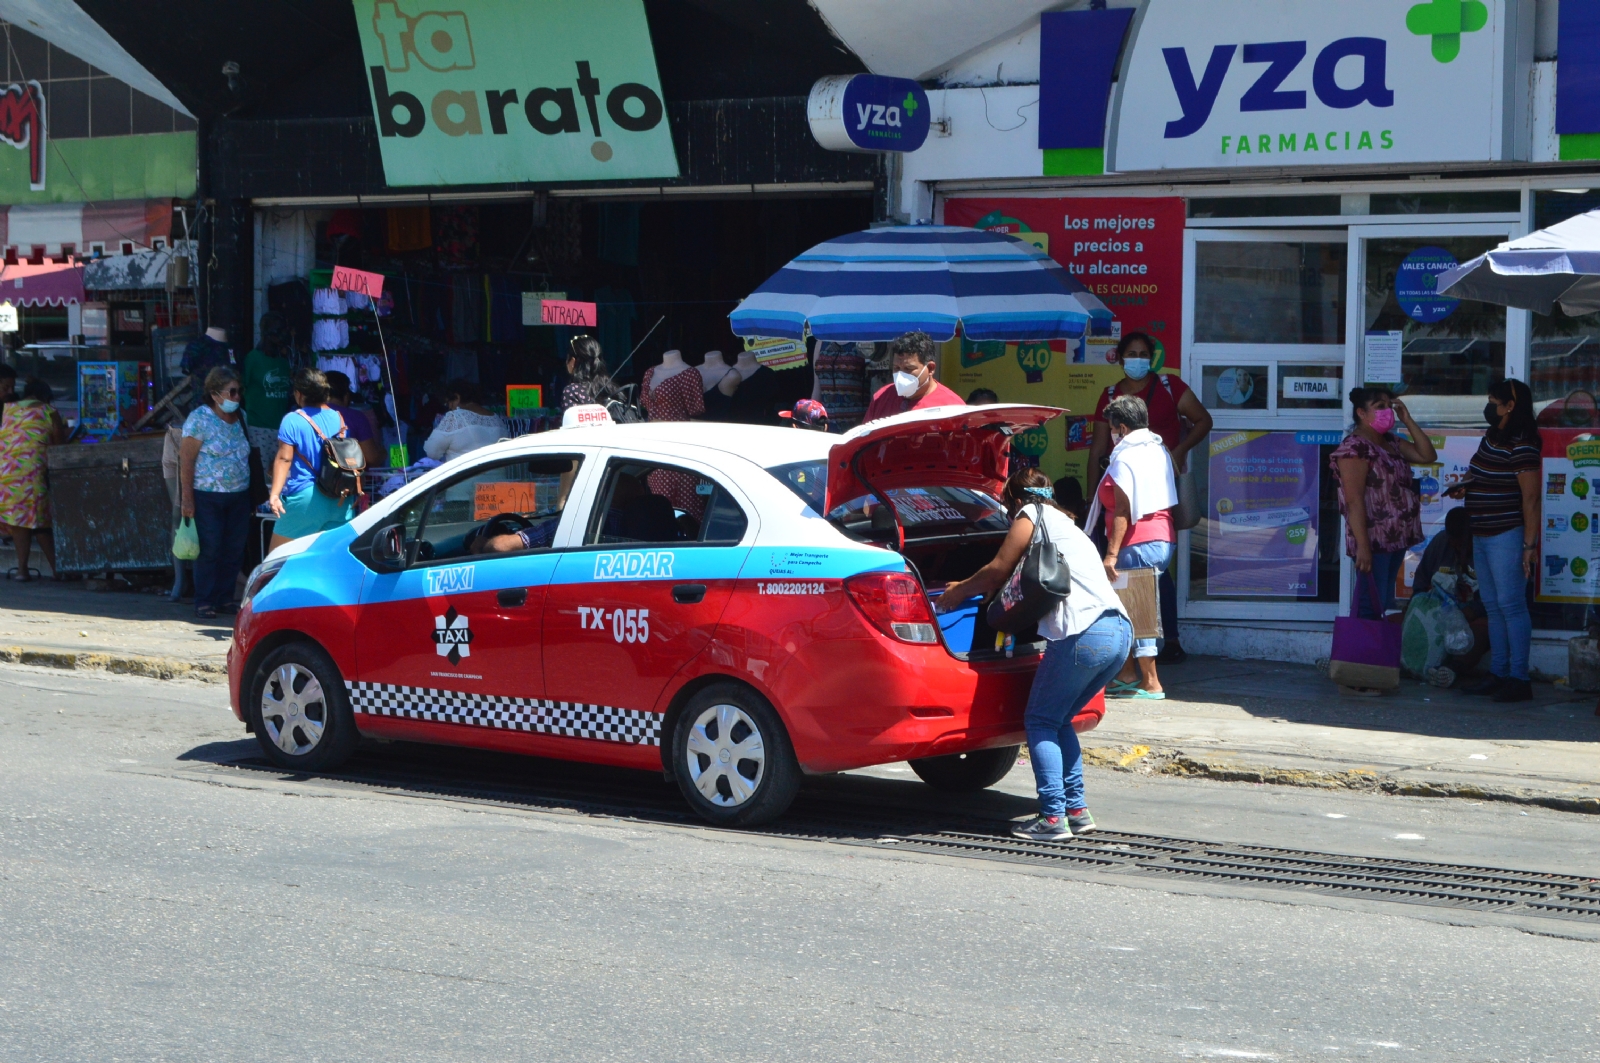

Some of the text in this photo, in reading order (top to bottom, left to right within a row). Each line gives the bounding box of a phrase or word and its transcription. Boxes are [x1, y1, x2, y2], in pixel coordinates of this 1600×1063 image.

[373, 0, 475, 72] ta
[1161, 37, 1394, 138] yza
[856, 102, 901, 130] yza
[1222, 130, 1394, 154] FARMACIAS
[1065, 214, 1155, 234] Los mejores
[1073, 238, 1143, 257] precios a
[1068, 259, 1147, 274] tu alcance
[335, 271, 368, 295] SALIDA
[1097, 284, 1108, 293] ES
[1111, 284, 1158, 294] CUANDO
[542, 305, 587, 326] ENTRADA
[1020, 348, 1049, 368] $40
[1293, 381, 1328, 393] ENTRADA
[578, 412, 607, 422] BAHIA
[1017, 433, 1047, 449] $195
[1212, 432, 1248, 453] ¡NUEVA!
[1568, 444, 1600, 457] OFERT
[1224, 456, 1304, 464] Descubre si tienes
[1225, 465, 1267, 473] COVID-19
[1229, 475, 1299, 483] prueba de saliva
[593, 551, 675, 580] RADAR
[427, 565, 475, 595] TAXI
[757, 582, 825, 595] T.8002202124
[577, 606, 649, 644] TX-055
[436, 628, 469, 644] TAXI
